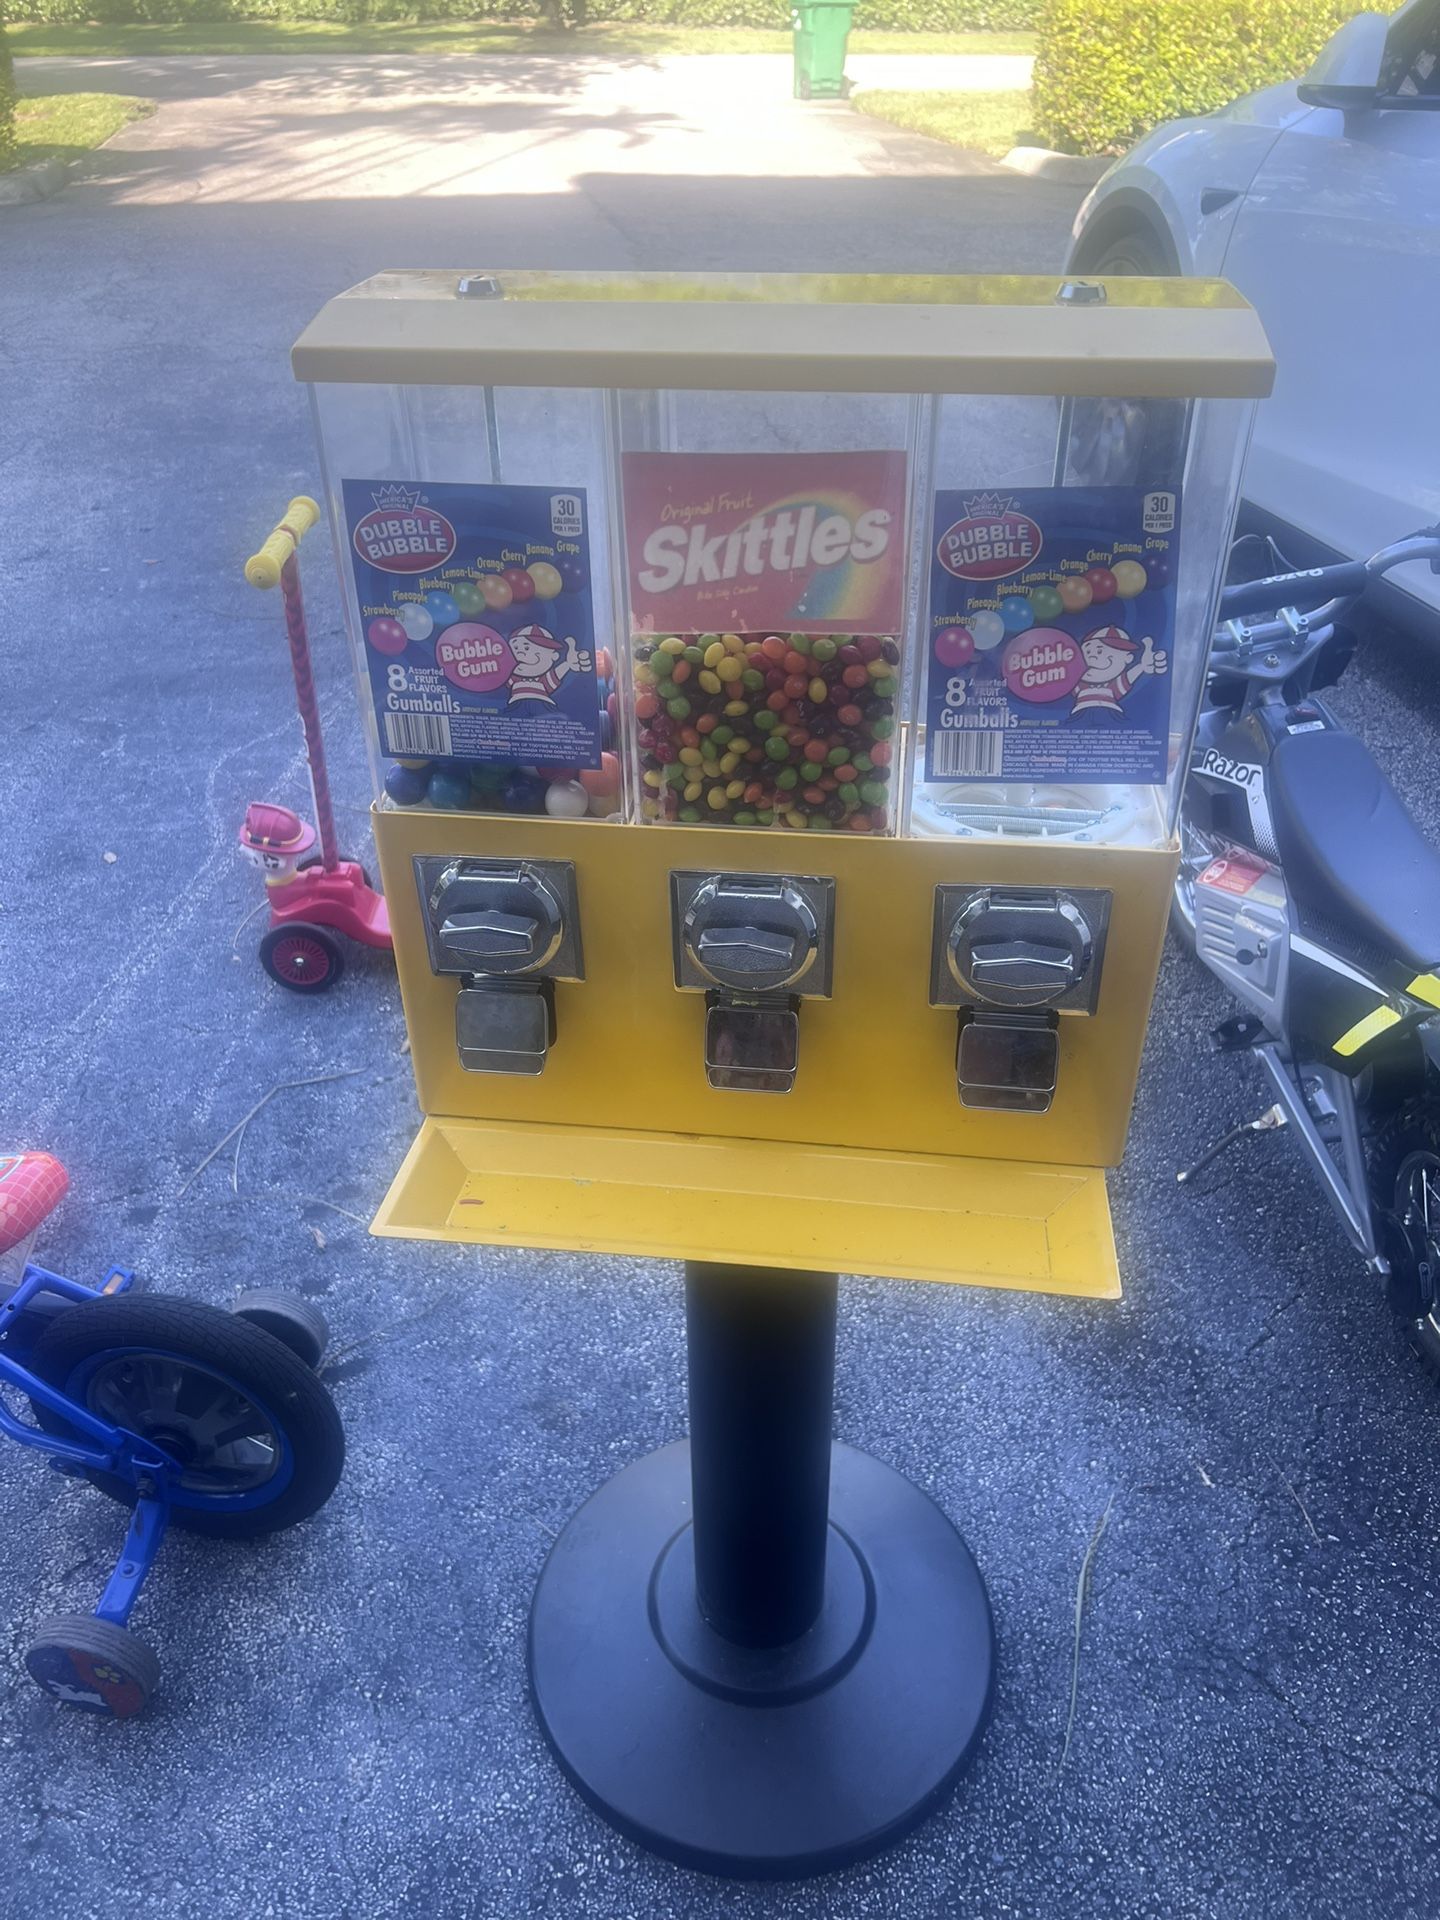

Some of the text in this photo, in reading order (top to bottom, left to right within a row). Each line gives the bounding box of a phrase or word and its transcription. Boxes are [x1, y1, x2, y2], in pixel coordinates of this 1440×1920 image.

[558, 499, 575, 516] 30
[660, 492, 754, 524] Original Fruit
[1151, 496, 1169, 513] 30
[553, 516, 580, 525] CALORIES
[360, 519, 442, 542] DUBBLE
[946, 524, 1029, 551] DUBBLE
[367, 537, 448, 560] BUBBLE
[526, 543, 554, 557] Banana
[556, 540, 580, 555] Grape
[638, 505, 891, 594] Skittles
[1113, 542, 1142, 554] Banana
[1145, 537, 1169, 552] Grape
[501, 549, 527, 565] Cherry
[950, 541, 1033, 568] BUBBLE
[1086, 549, 1113, 565] Cherry
[477, 557, 505, 572] Orange
[1060, 558, 1089, 573] Orange
[441, 566, 486, 581] Lemon-Lime
[1021, 569, 1067, 584] Lemon-Lime
[419, 578, 456, 594] Blueberry
[996, 582, 1034, 598] Blueberry
[392, 590, 428, 604] Pineapple
[967, 597, 1003, 612] Pineapple
[362, 605, 405, 621] Strawberry
[933, 614, 977, 631] Strawberry
[441, 638, 503, 663] Bubble
[1008, 643, 1074, 671] Bubble
[408, 666, 444, 677] Assorted
[457, 660, 499, 678] Gum
[1022, 666, 1066, 688] Gum
[387, 664, 408, 692] 8
[414, 675, 440, 685] FRUIT
[408, 683, 448, 694] FLAVORS
[945, 677, 966, 707] 8
[974, 687, 1000, 697] FRUIT
[386, 692, 461, 714] Gumballs
[967, 696, 1008, 707] FLAVORS
[940, 707, 1019, 729] Gumballs
[1201, 748, 1262, 785] Razor
